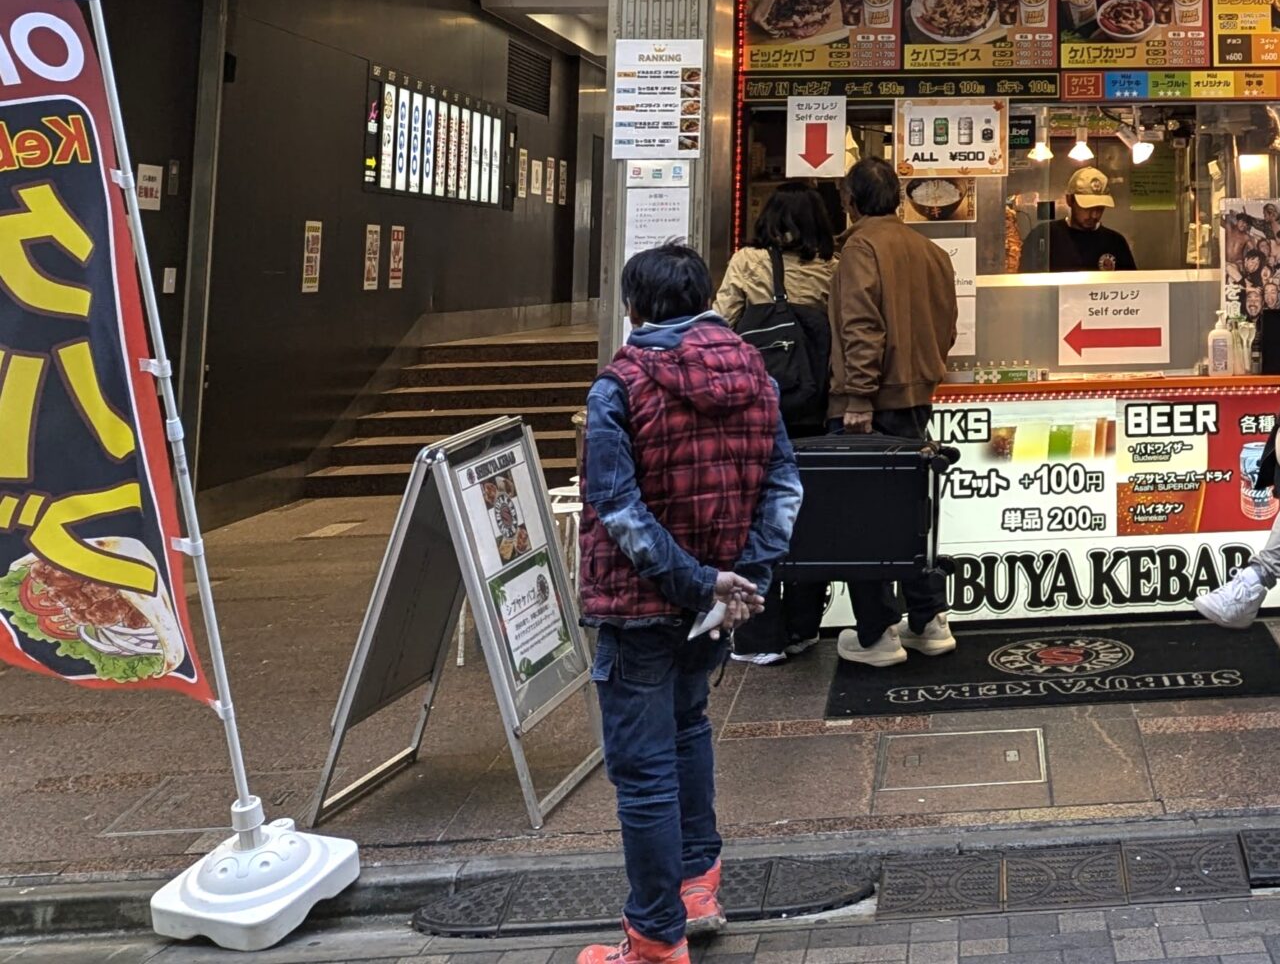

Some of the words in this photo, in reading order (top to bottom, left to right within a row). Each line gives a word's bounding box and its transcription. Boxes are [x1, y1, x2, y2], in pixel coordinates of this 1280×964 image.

[638, 53, 682, 63] RANKING
[749, 48, 817, 63] ビッグケバブ
[910, 48, 982, 62] ケバブライス
[1068, 46, 1138, 60] ケバブカップ
[1225, 52, 1243, 61] ¥600
[1261, 52, 1278, 61] ¥600
[1071, 76, 1095, 86] ケバブ
[1151, 80, 1188, 88] ヨーグルト
[775, 82, 790, 95] IN
[845, 82, 874, 95] チーズ
[959, 81, 986, 94] 100円
[1028, 80, 1056, 93] 100円
[1071, 86, 1096, 95] ソース
[796, 101, 838, 111] セルフレジ
[795, 113, 813, 121] Self
[815, 113, 838, 121] order
[911, 150, 939, 162] ALL
[949, 150, 985, 162] ¥500
[1088, 290, 1140, 302] セルフレジ
[1088, 306, 1109, 317] Self
[1112, 306, 1141, 317] order
[1126, 403, 1218, 436] BEER
[926, 408, 992, 444] NKS
[1134, 441, 1193, 454] バドワイザー
[1133, 453, 1171, 462] Budweiser
[1133, 483, 1155, 492] Asahi
[1135, 503, 1184, 515] ハイネケン
[1003, 508, 1042, 531] 単品
[1048, 507, 1106, 531] 200円
[1133, 513, 1168, 522] Heineken
[945, 549, 1088, 614] BUYA
